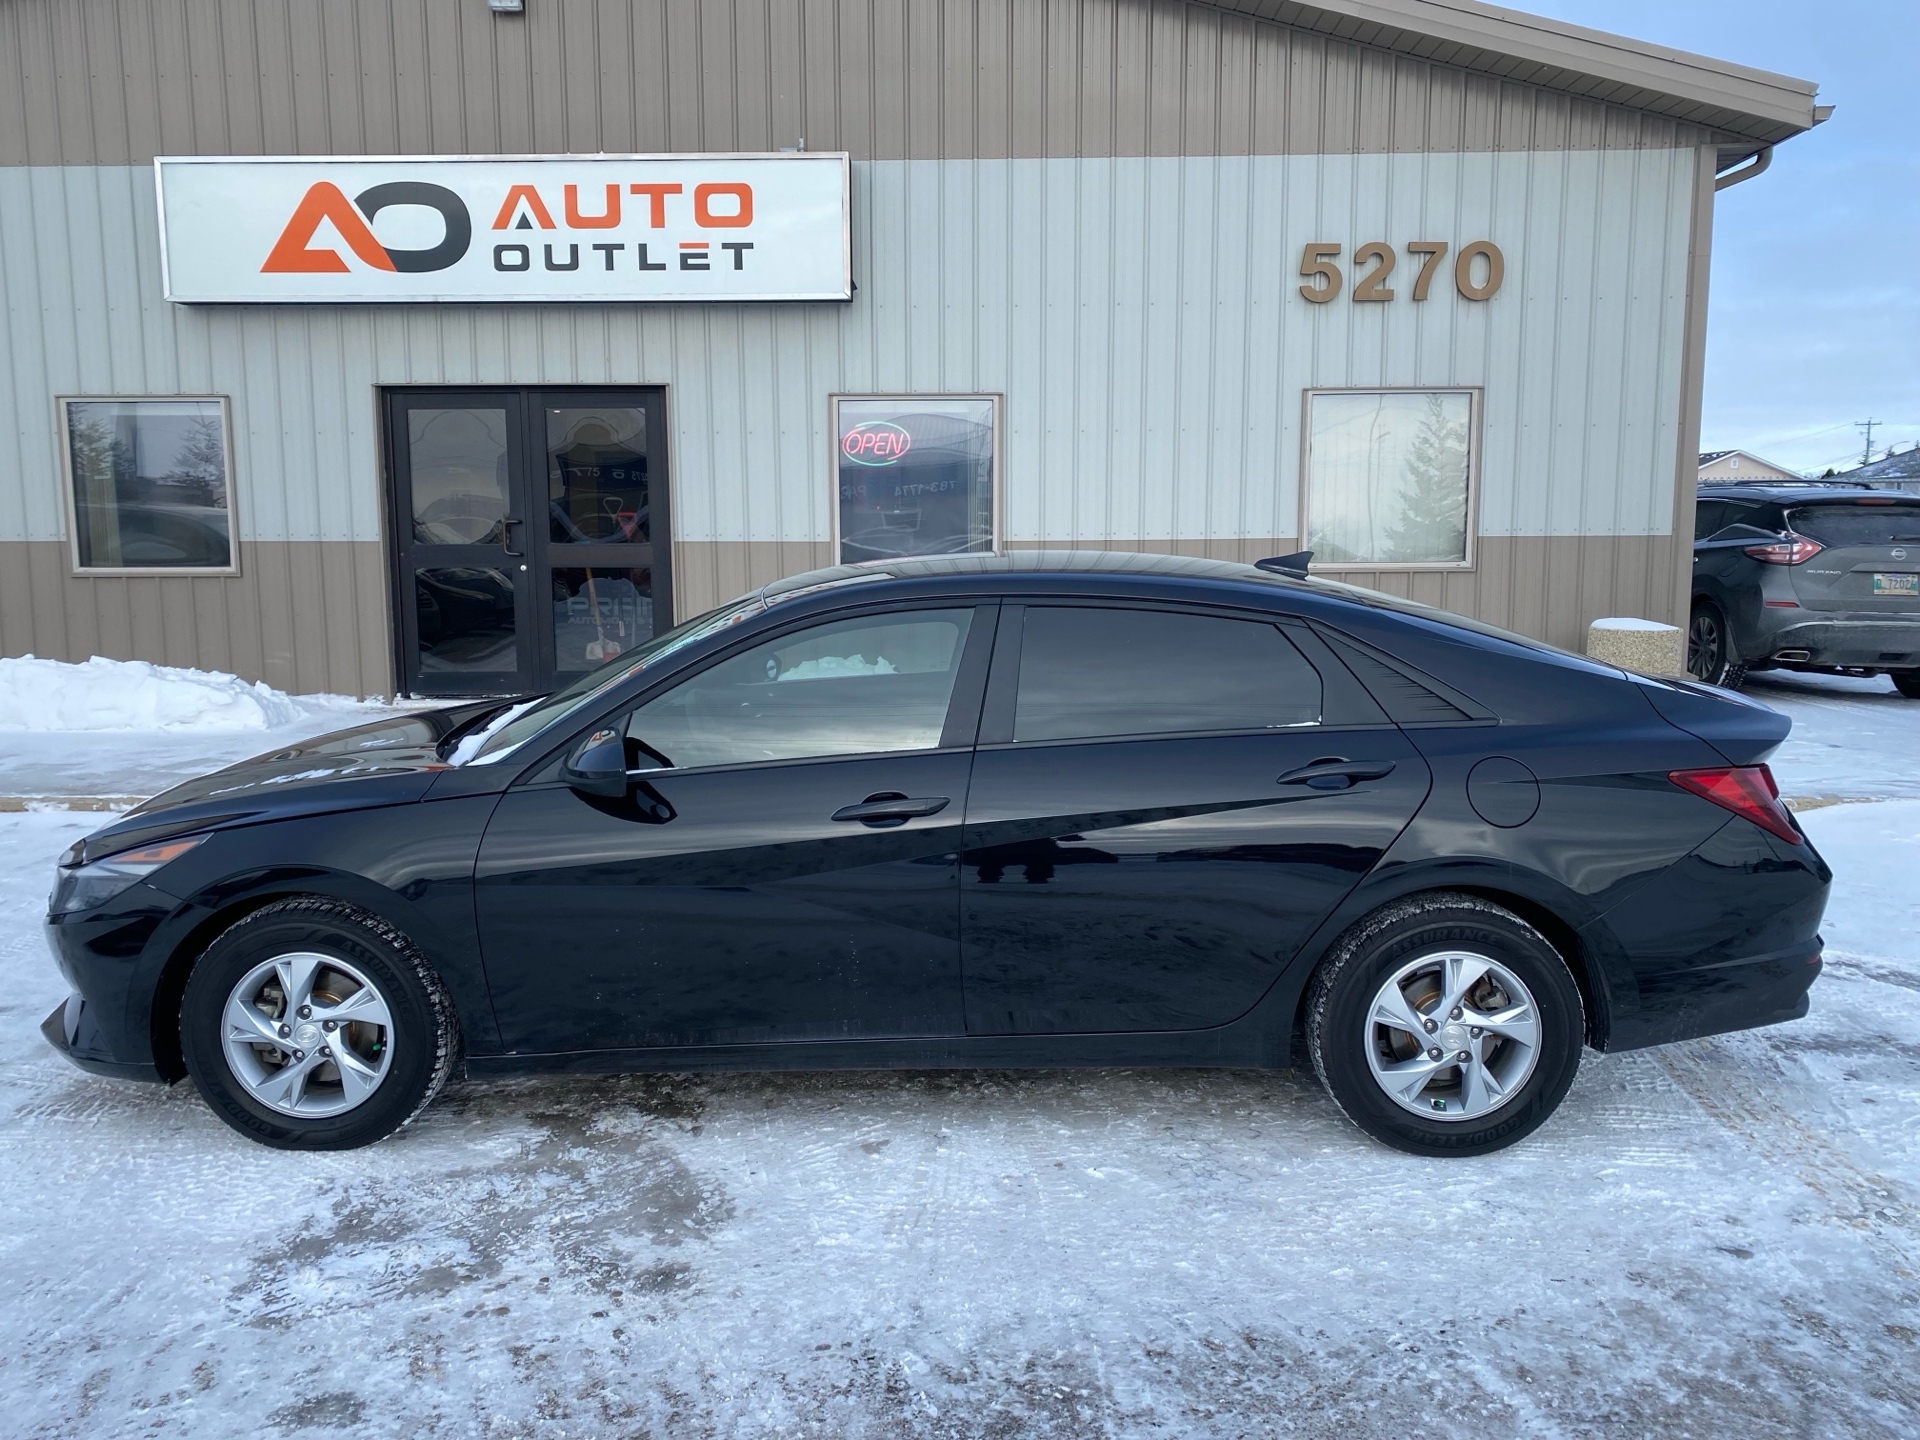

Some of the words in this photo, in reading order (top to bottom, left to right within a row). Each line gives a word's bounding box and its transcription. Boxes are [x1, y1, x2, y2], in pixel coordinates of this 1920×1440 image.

[492, 182, 754, 231] AUTO
[492, 242, 754, 272] OUTLET
[1299, 240, 1505, 303] 5270
[845, 433, 904, 455] OPEN
[1390, 929, 1500, 957] ASSURANCE
